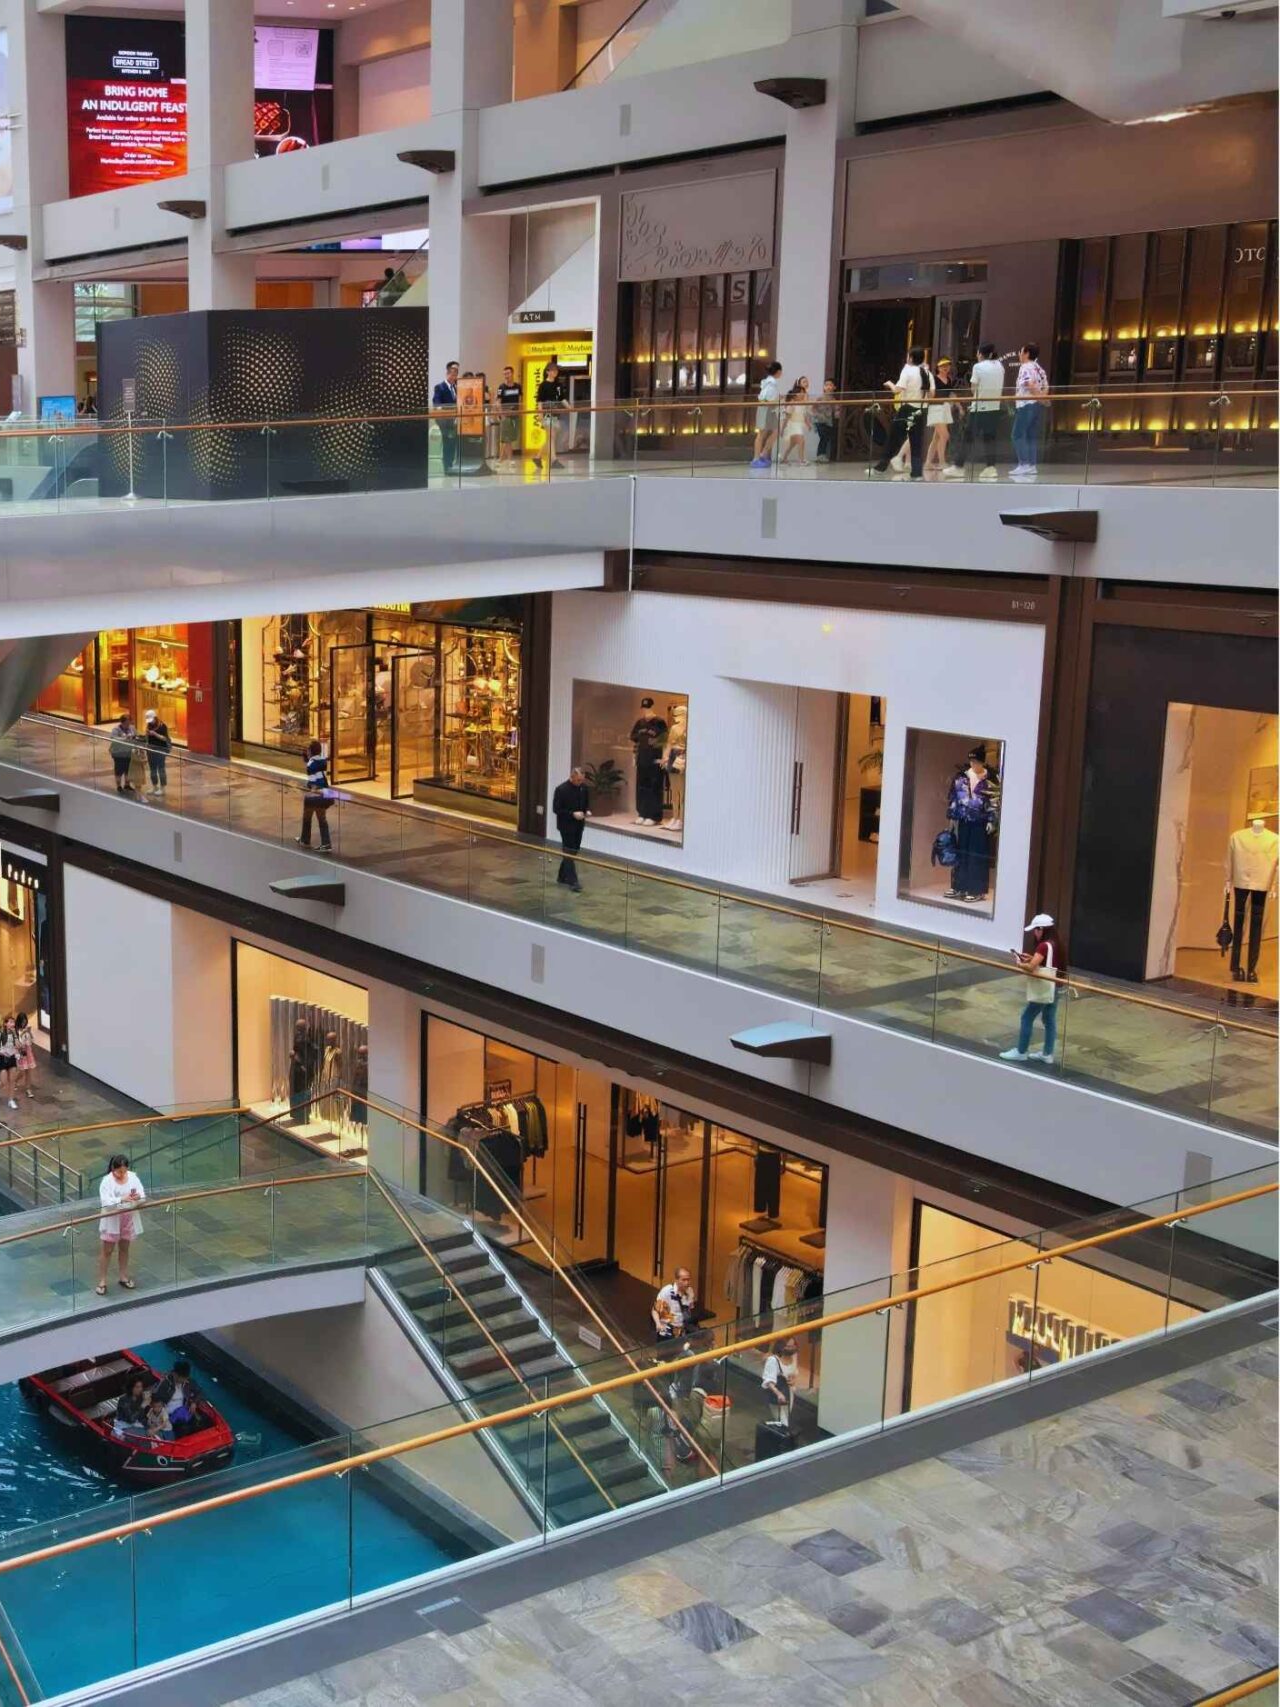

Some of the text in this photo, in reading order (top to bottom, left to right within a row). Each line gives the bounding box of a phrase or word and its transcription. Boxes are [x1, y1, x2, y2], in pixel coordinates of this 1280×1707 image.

[104, 85, 168, 98] BRING HOME
[82, 100, 98, 110] AN
[100, 100, 159, 112] INDULGENT
[523, 312, 541, 321] ATM
[567, 343, 593, 353] Mayban
